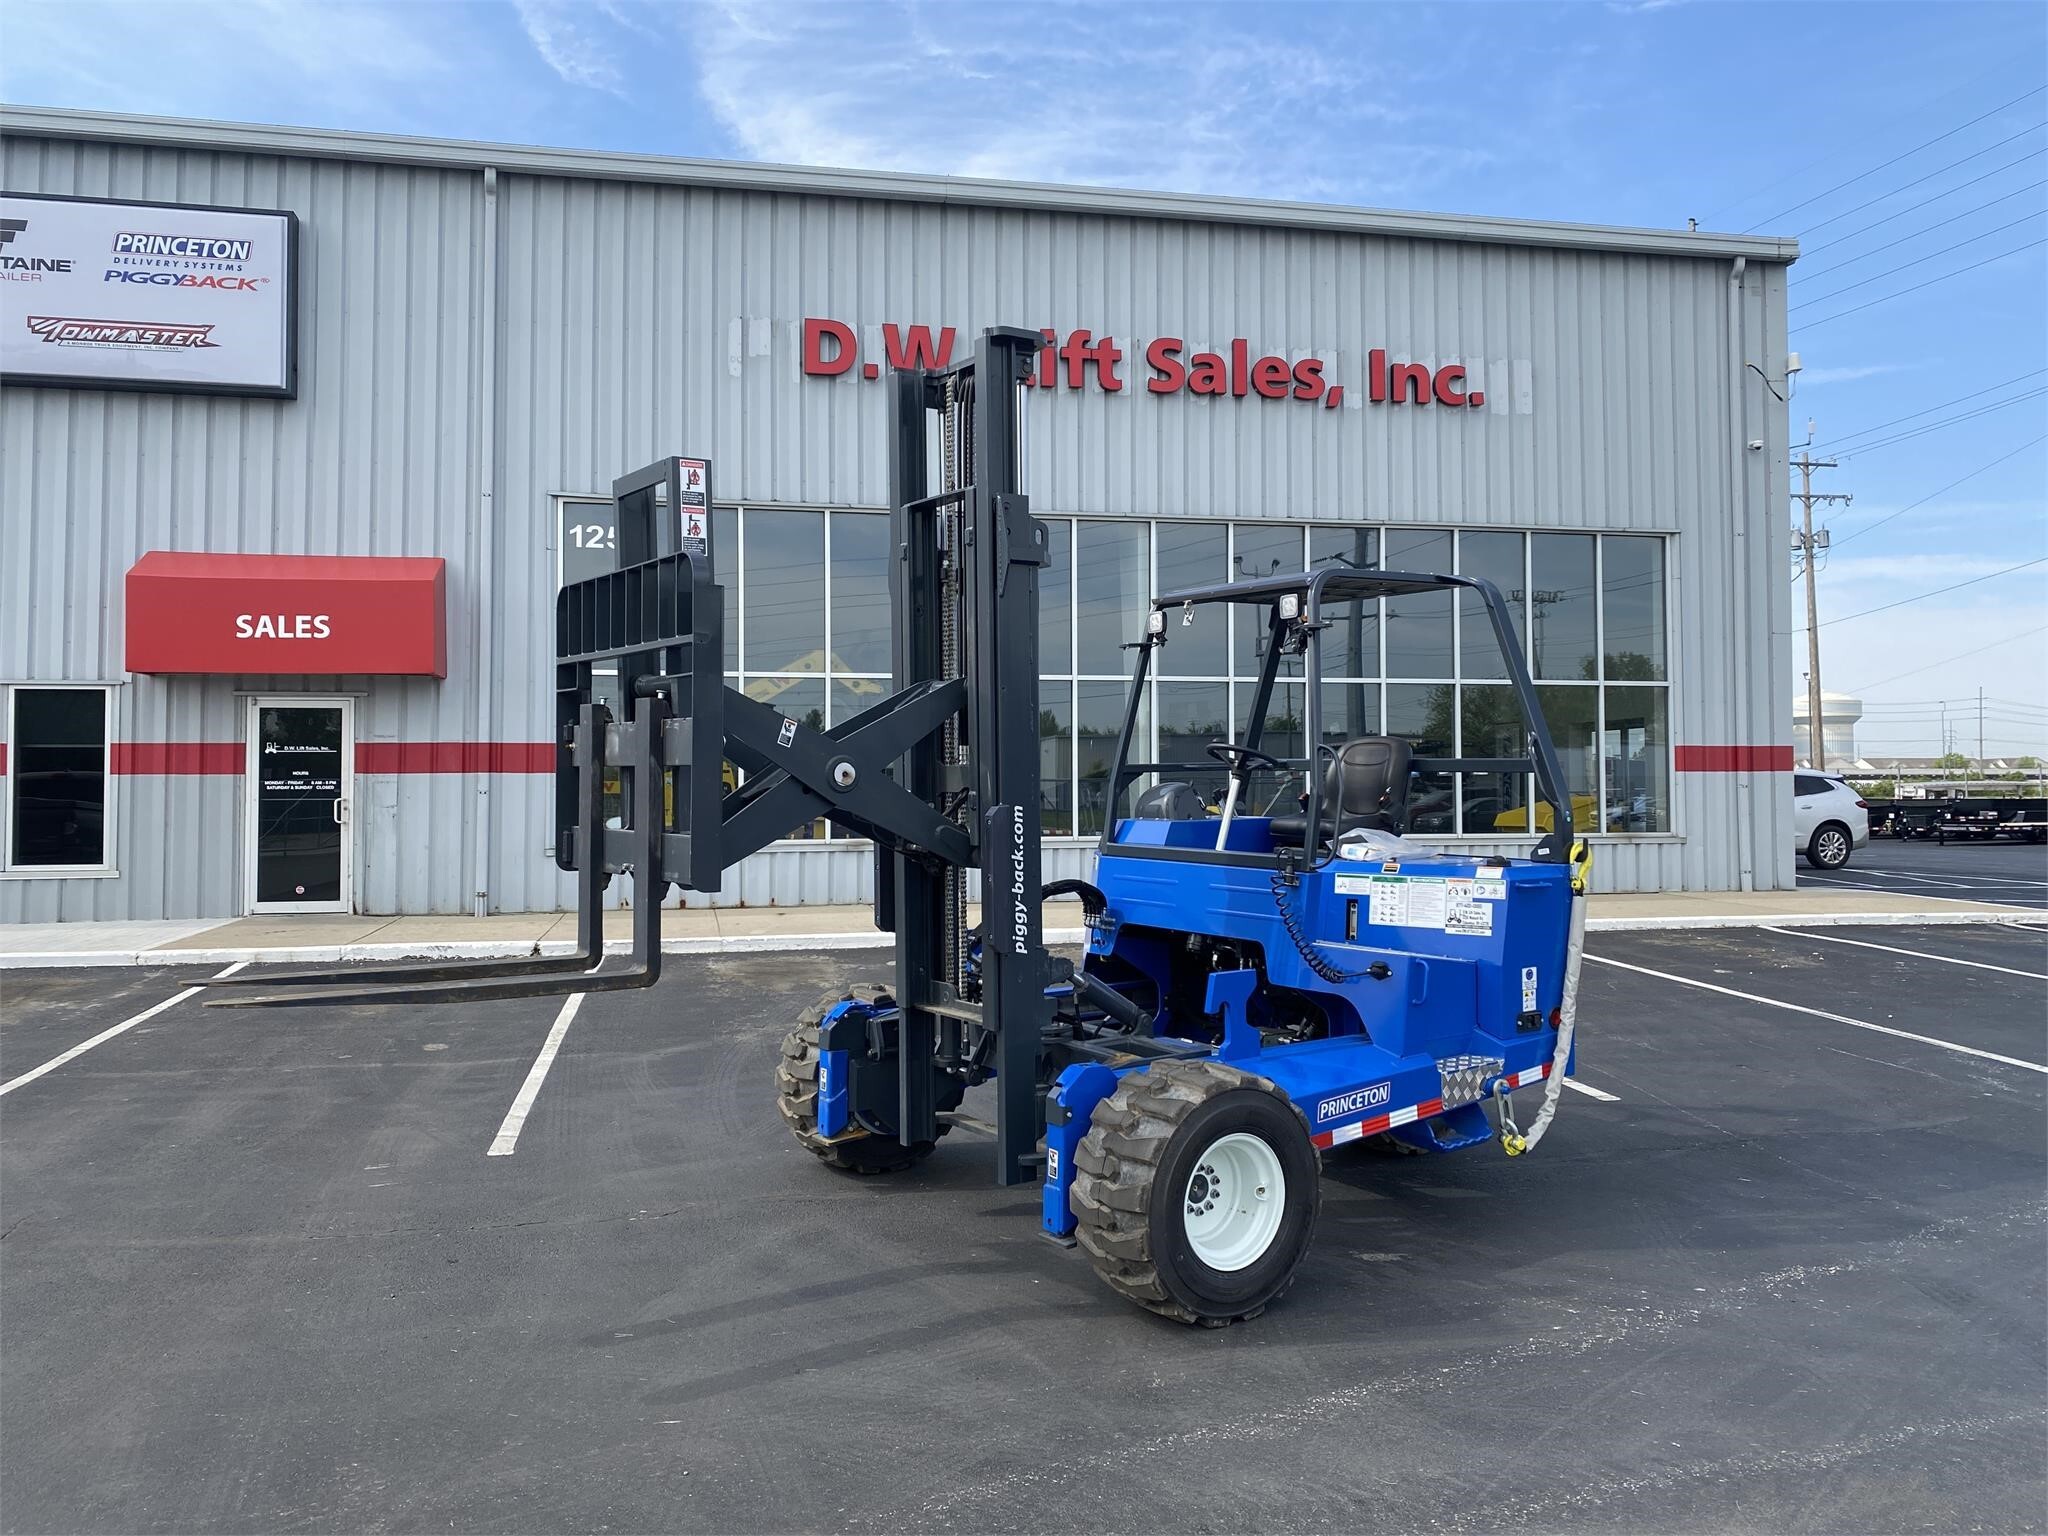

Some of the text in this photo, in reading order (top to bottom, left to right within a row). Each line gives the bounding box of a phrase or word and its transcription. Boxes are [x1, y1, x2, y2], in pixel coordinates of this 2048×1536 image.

[115, 233, 250, 260] PRINCETON
[113, 256, 243, 272] DELIVERY SYSTEMS
[38, 318, 209, 347] TOWMASTER
[1026, 328, 1122, 392] ift
[1146, 337, 1344, 408] Sales,
[1369, 348, 1485, 407] Inc.
[235, 614, 331, 639] SALES
[1011, 805, 1028, 955] piggy-back.com
[1320, 1085, 1388, 1119] PRINCETON
